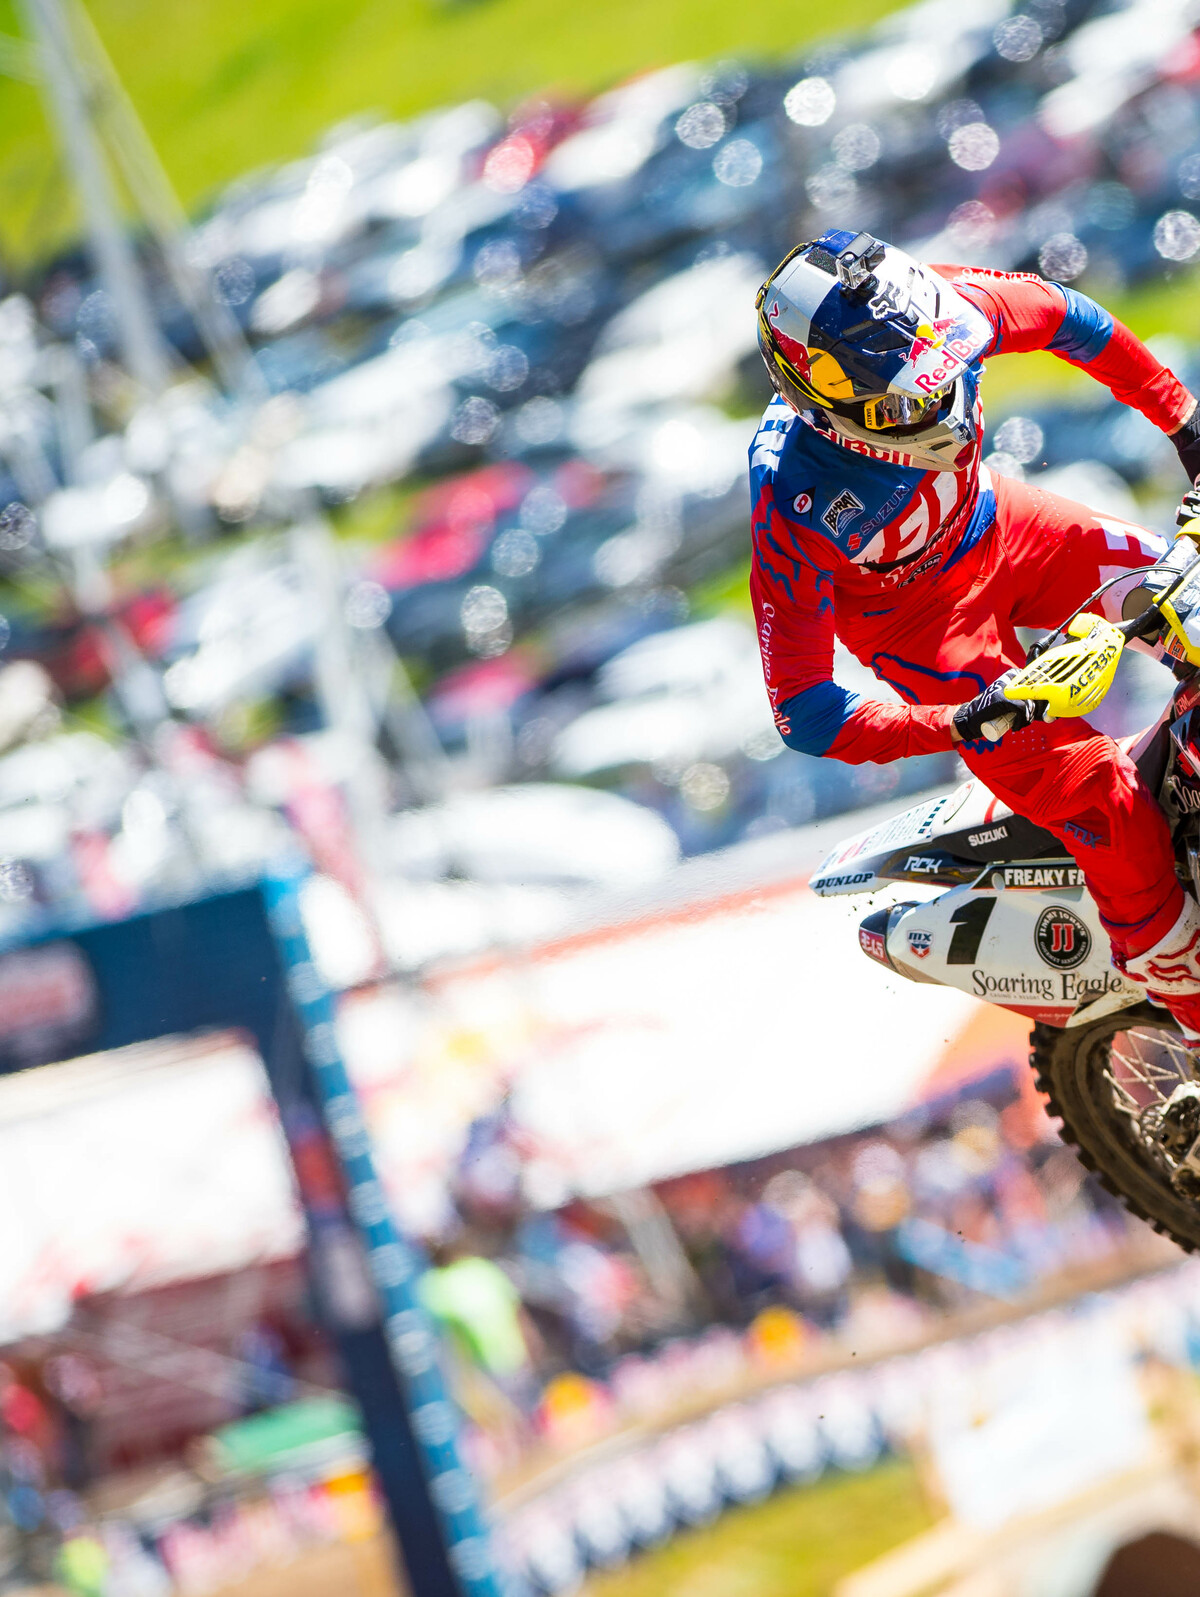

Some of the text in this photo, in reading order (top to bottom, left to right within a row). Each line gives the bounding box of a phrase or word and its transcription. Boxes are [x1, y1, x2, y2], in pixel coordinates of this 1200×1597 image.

[914, 327, 981, 394] Red Bul
[860, 481, 913, 536] SUZUKI
[968, 826, 1008, 847] SUZUKI
[1064, 821, 1104, 849] FOX
[904, 856, 942, 874] RCH
[1004, 869, 1065, 885] FREAKY
[814, 872, 874, 889] DUNLOP
[947, 897, 998, 965] 1
[1039, 911, 1058, 937] JIMMY
[1051, 923, 1074, 952] JJ
[972, 969, 1123, 1001] Soaring Eagle
